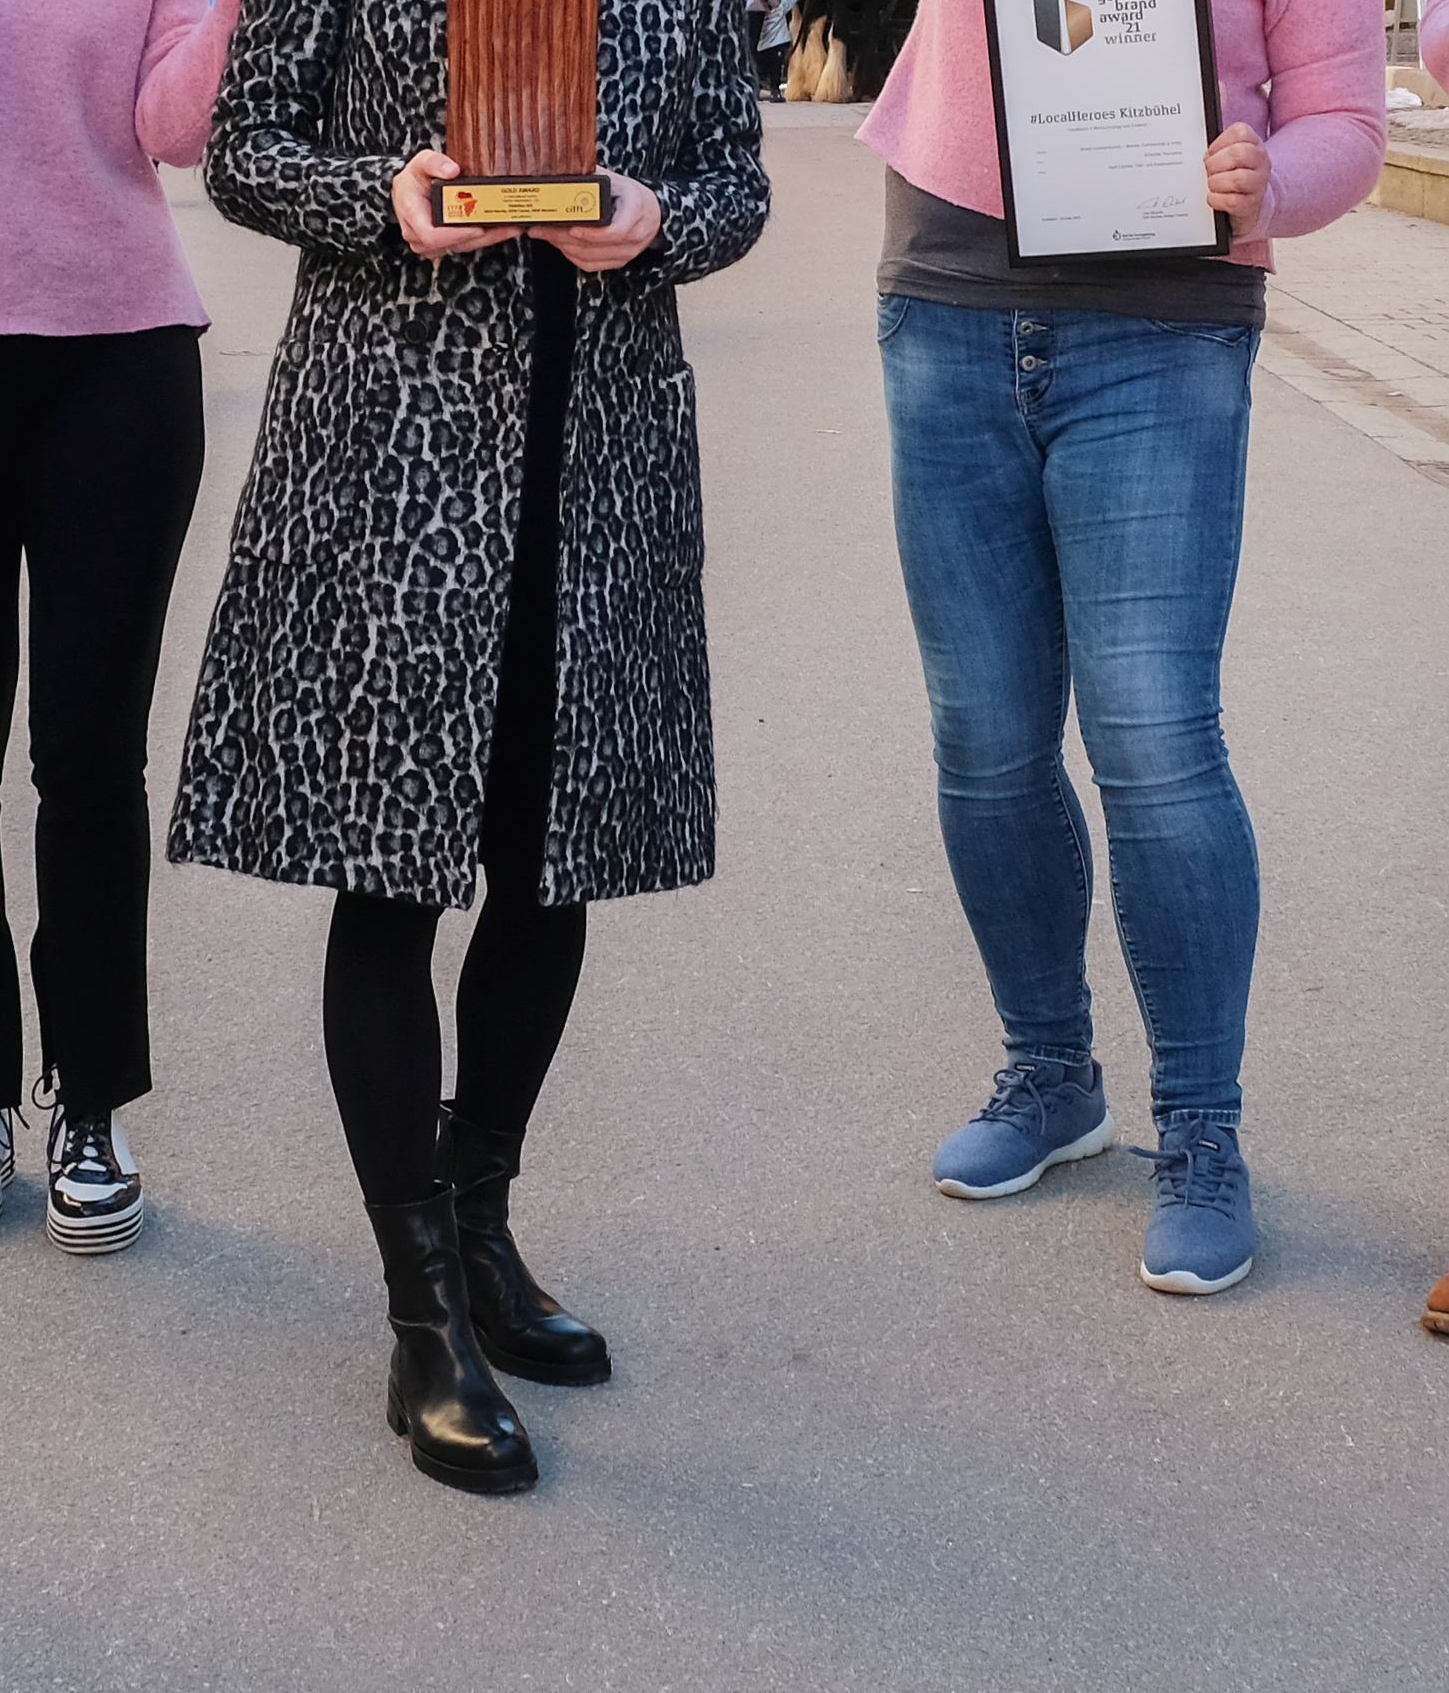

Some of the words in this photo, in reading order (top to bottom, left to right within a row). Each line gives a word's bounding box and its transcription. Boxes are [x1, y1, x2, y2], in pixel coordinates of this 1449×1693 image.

[1100, 10, 1143, 24] award
[1126, 22, 1141, 33] 21
[1104, 32, 1157, 45] winner
[1030, 109, 1115, 125] #LocalHeroes
[1120, 103, 1182, 119] Kitzbühel
